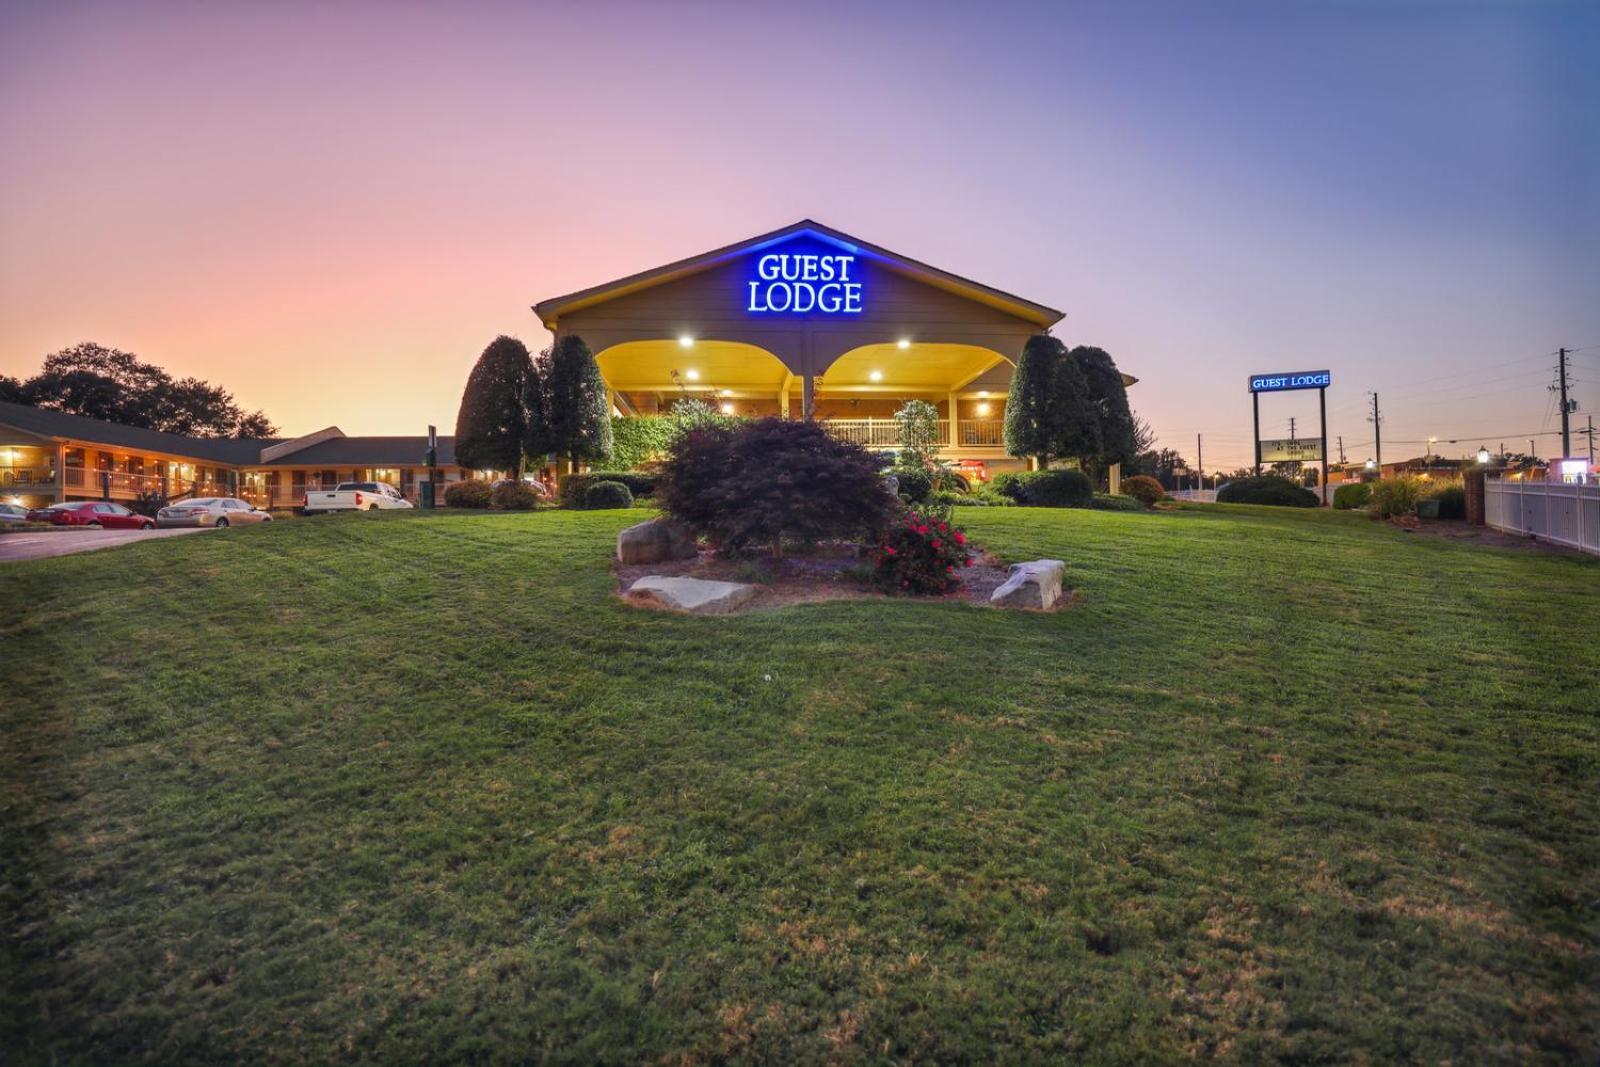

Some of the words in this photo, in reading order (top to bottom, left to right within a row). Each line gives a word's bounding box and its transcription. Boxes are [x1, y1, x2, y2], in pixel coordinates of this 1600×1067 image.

[758, 254, 854, 281] GUEST
[748, 281, 862, 312] LODGE
[1253, 377, 1288, 389] GUEST
[1291, 374, 1329, 386] LODGE
